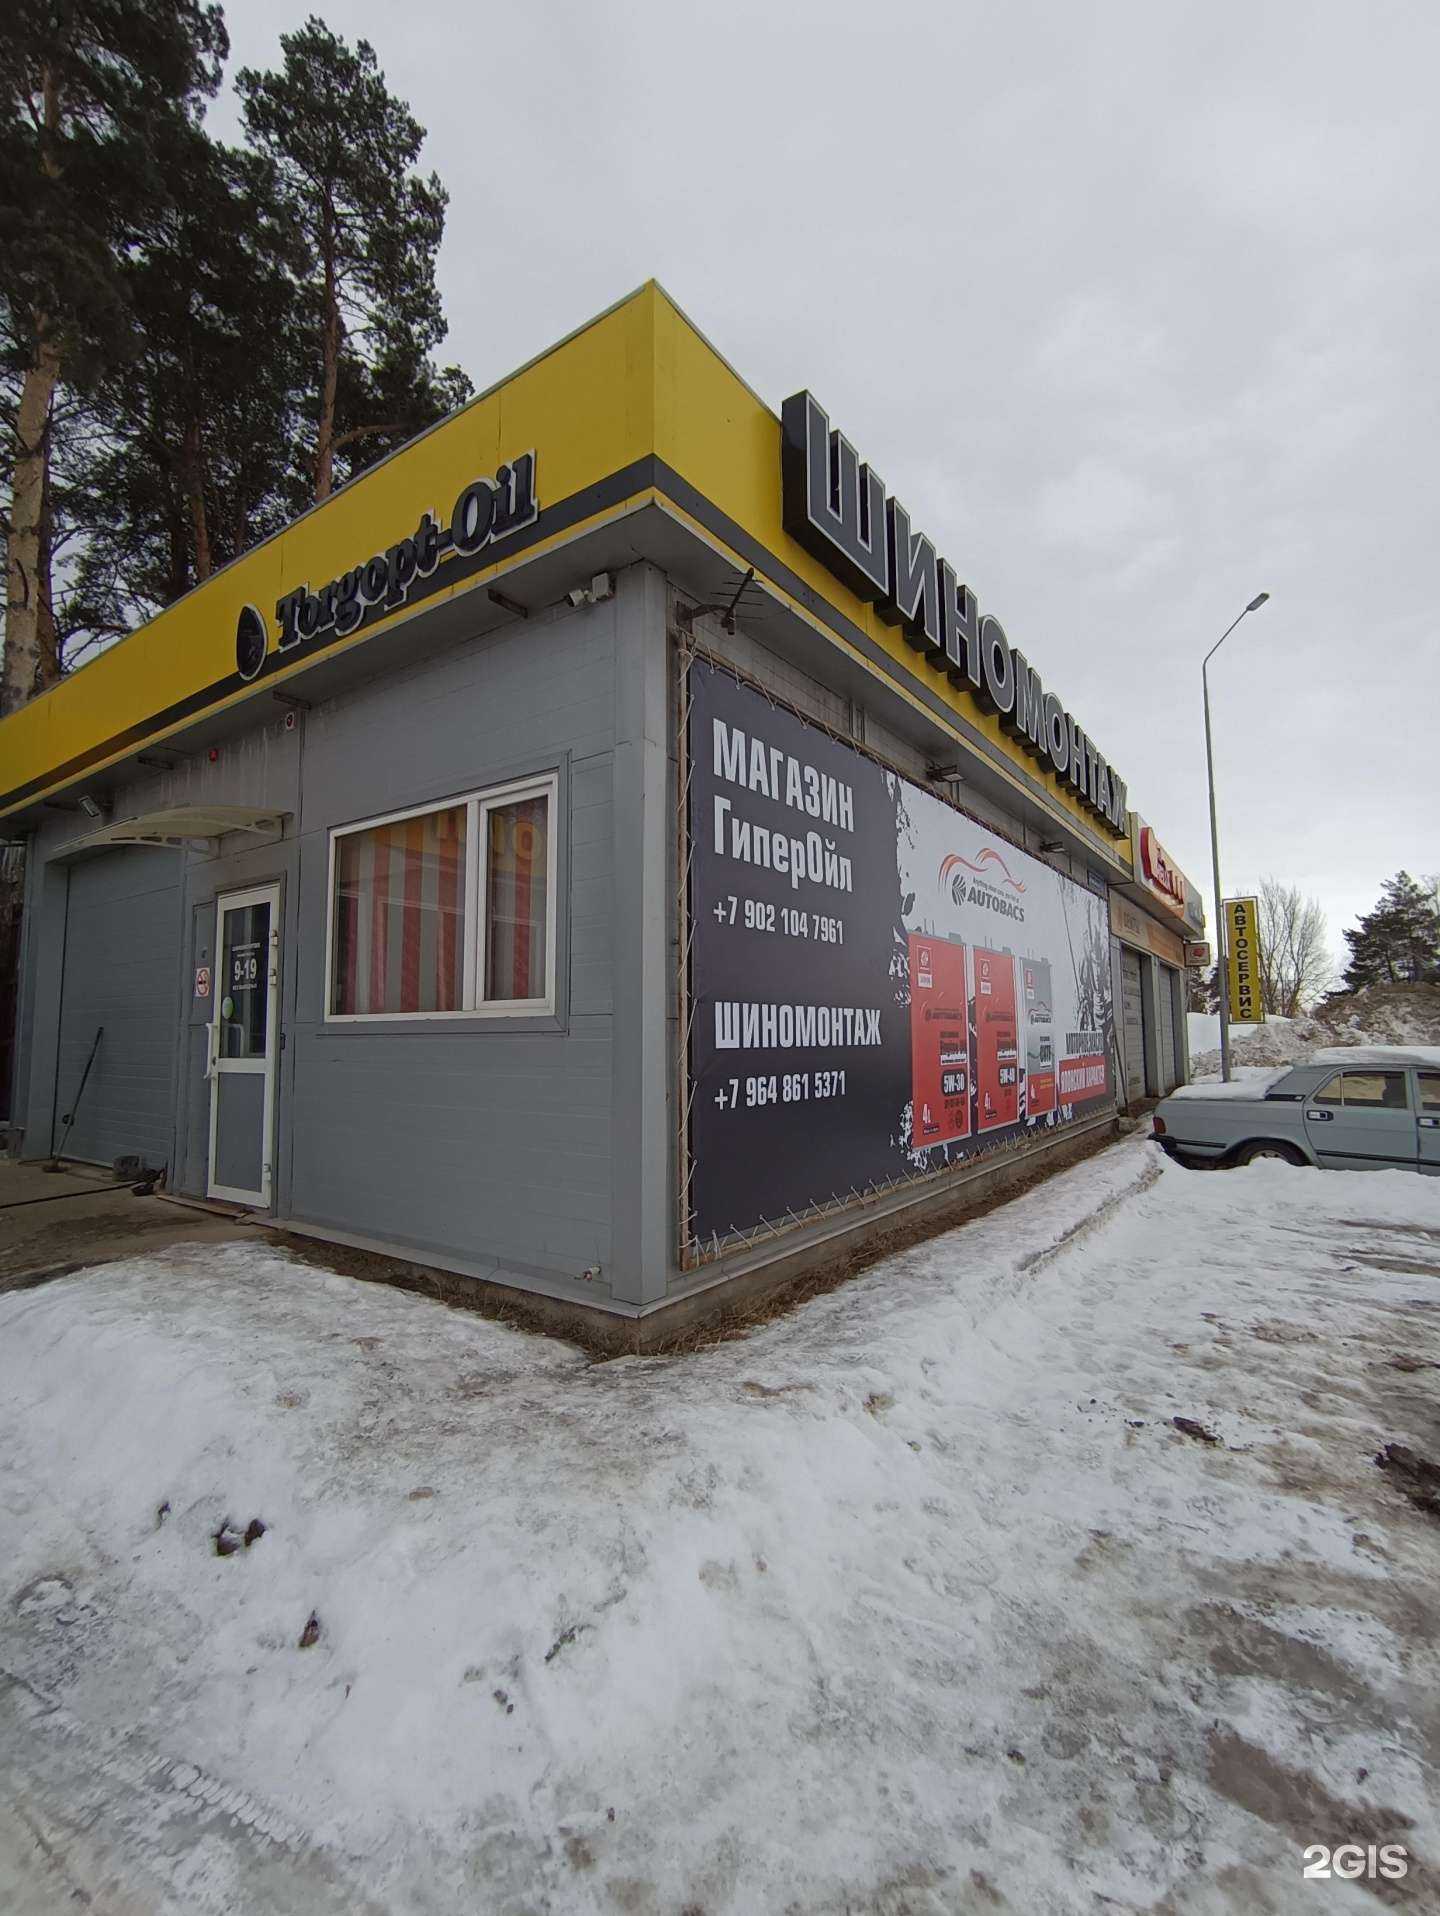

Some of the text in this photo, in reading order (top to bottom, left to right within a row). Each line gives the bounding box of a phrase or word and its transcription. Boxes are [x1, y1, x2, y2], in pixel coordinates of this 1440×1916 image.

[275, 449, 538, 652] Torgopt-Oil
[784, 389, 1128, 838] ШИНОМОНТАЖ
[713, 718, 854, 832] МАГАЗИН
[714, 795, 853, 892] ГиперОйл
[713, 896, 844, 944] +7 902 104 7961
[967, 886, 1025, 922] AUTOBACS
[234, 958, 257, 981] 9-19
[1234, 904, 1252, 1019] АВТОСЕРВИС
[715, 1002, 882, 1049] ШИНОМОНТАЖ
[714, 1070, 847, 1110] +7 964 861 5371
[943, 1073, 966, 1094] 5W-30
